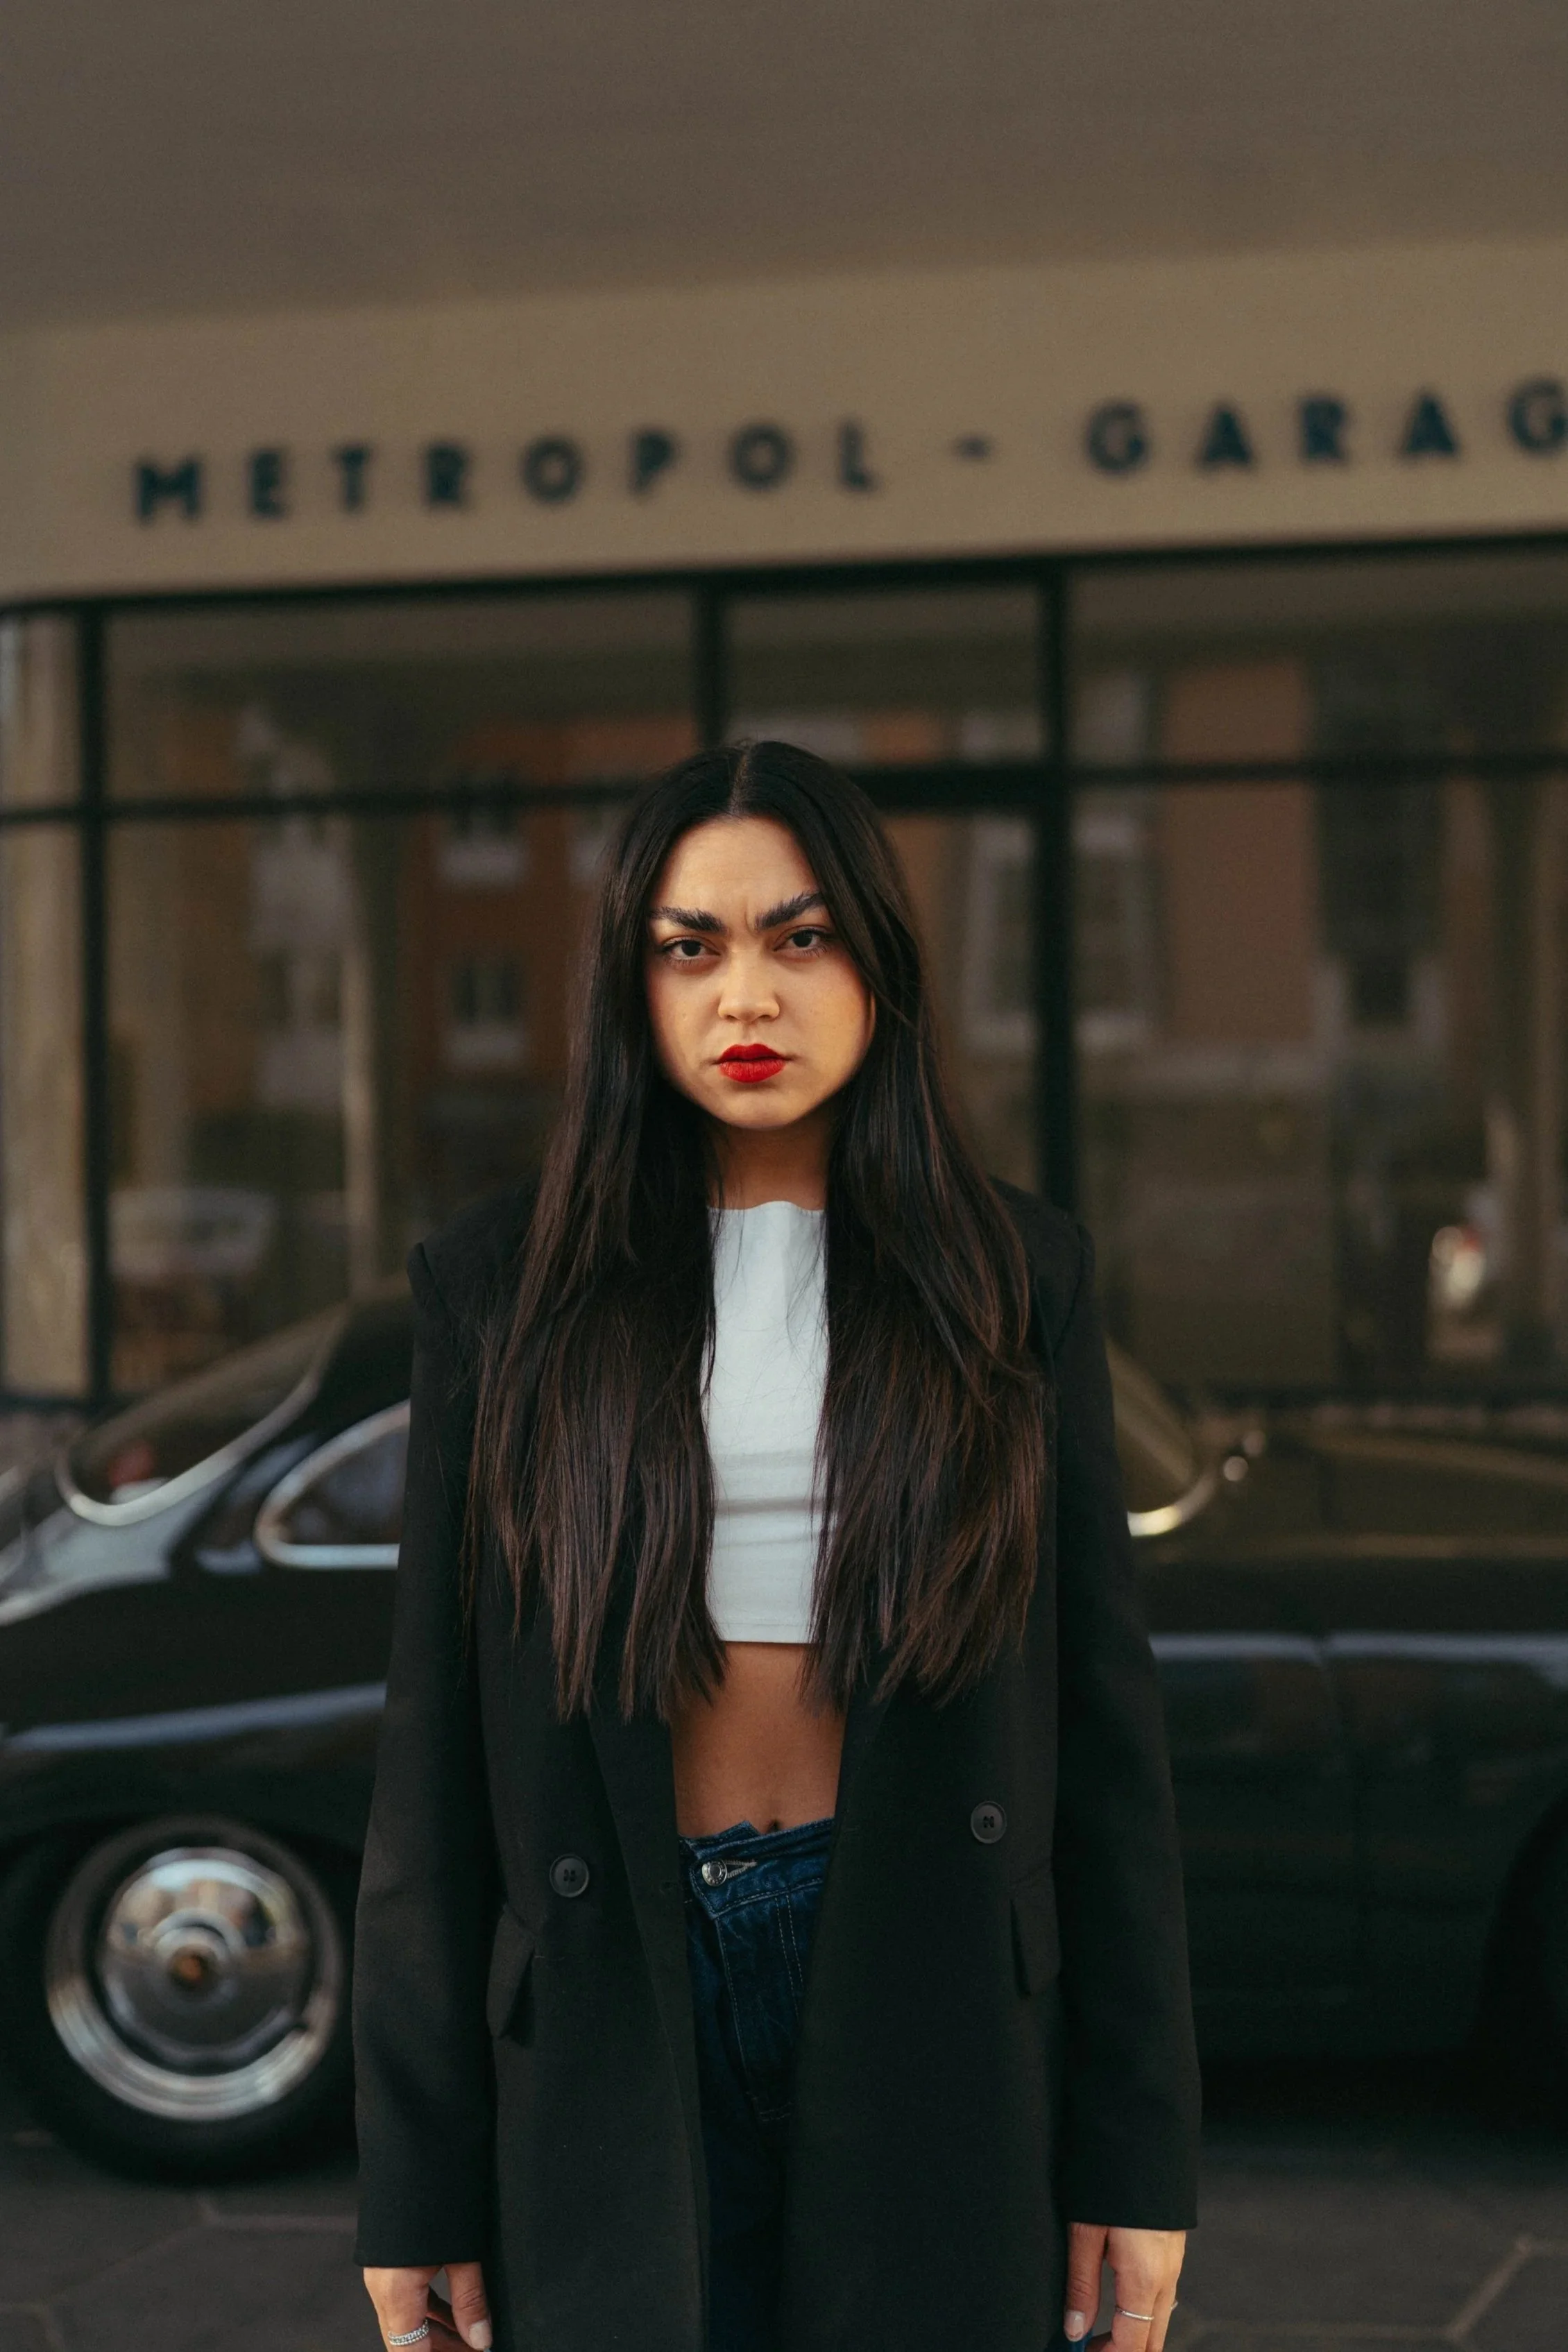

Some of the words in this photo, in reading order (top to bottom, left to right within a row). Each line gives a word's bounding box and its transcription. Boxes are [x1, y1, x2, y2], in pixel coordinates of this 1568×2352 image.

[133, 419, 878, 524] METROPOL
[955, 434, 992, 462] -
[1084, 376, 1568, 479] GARAG
